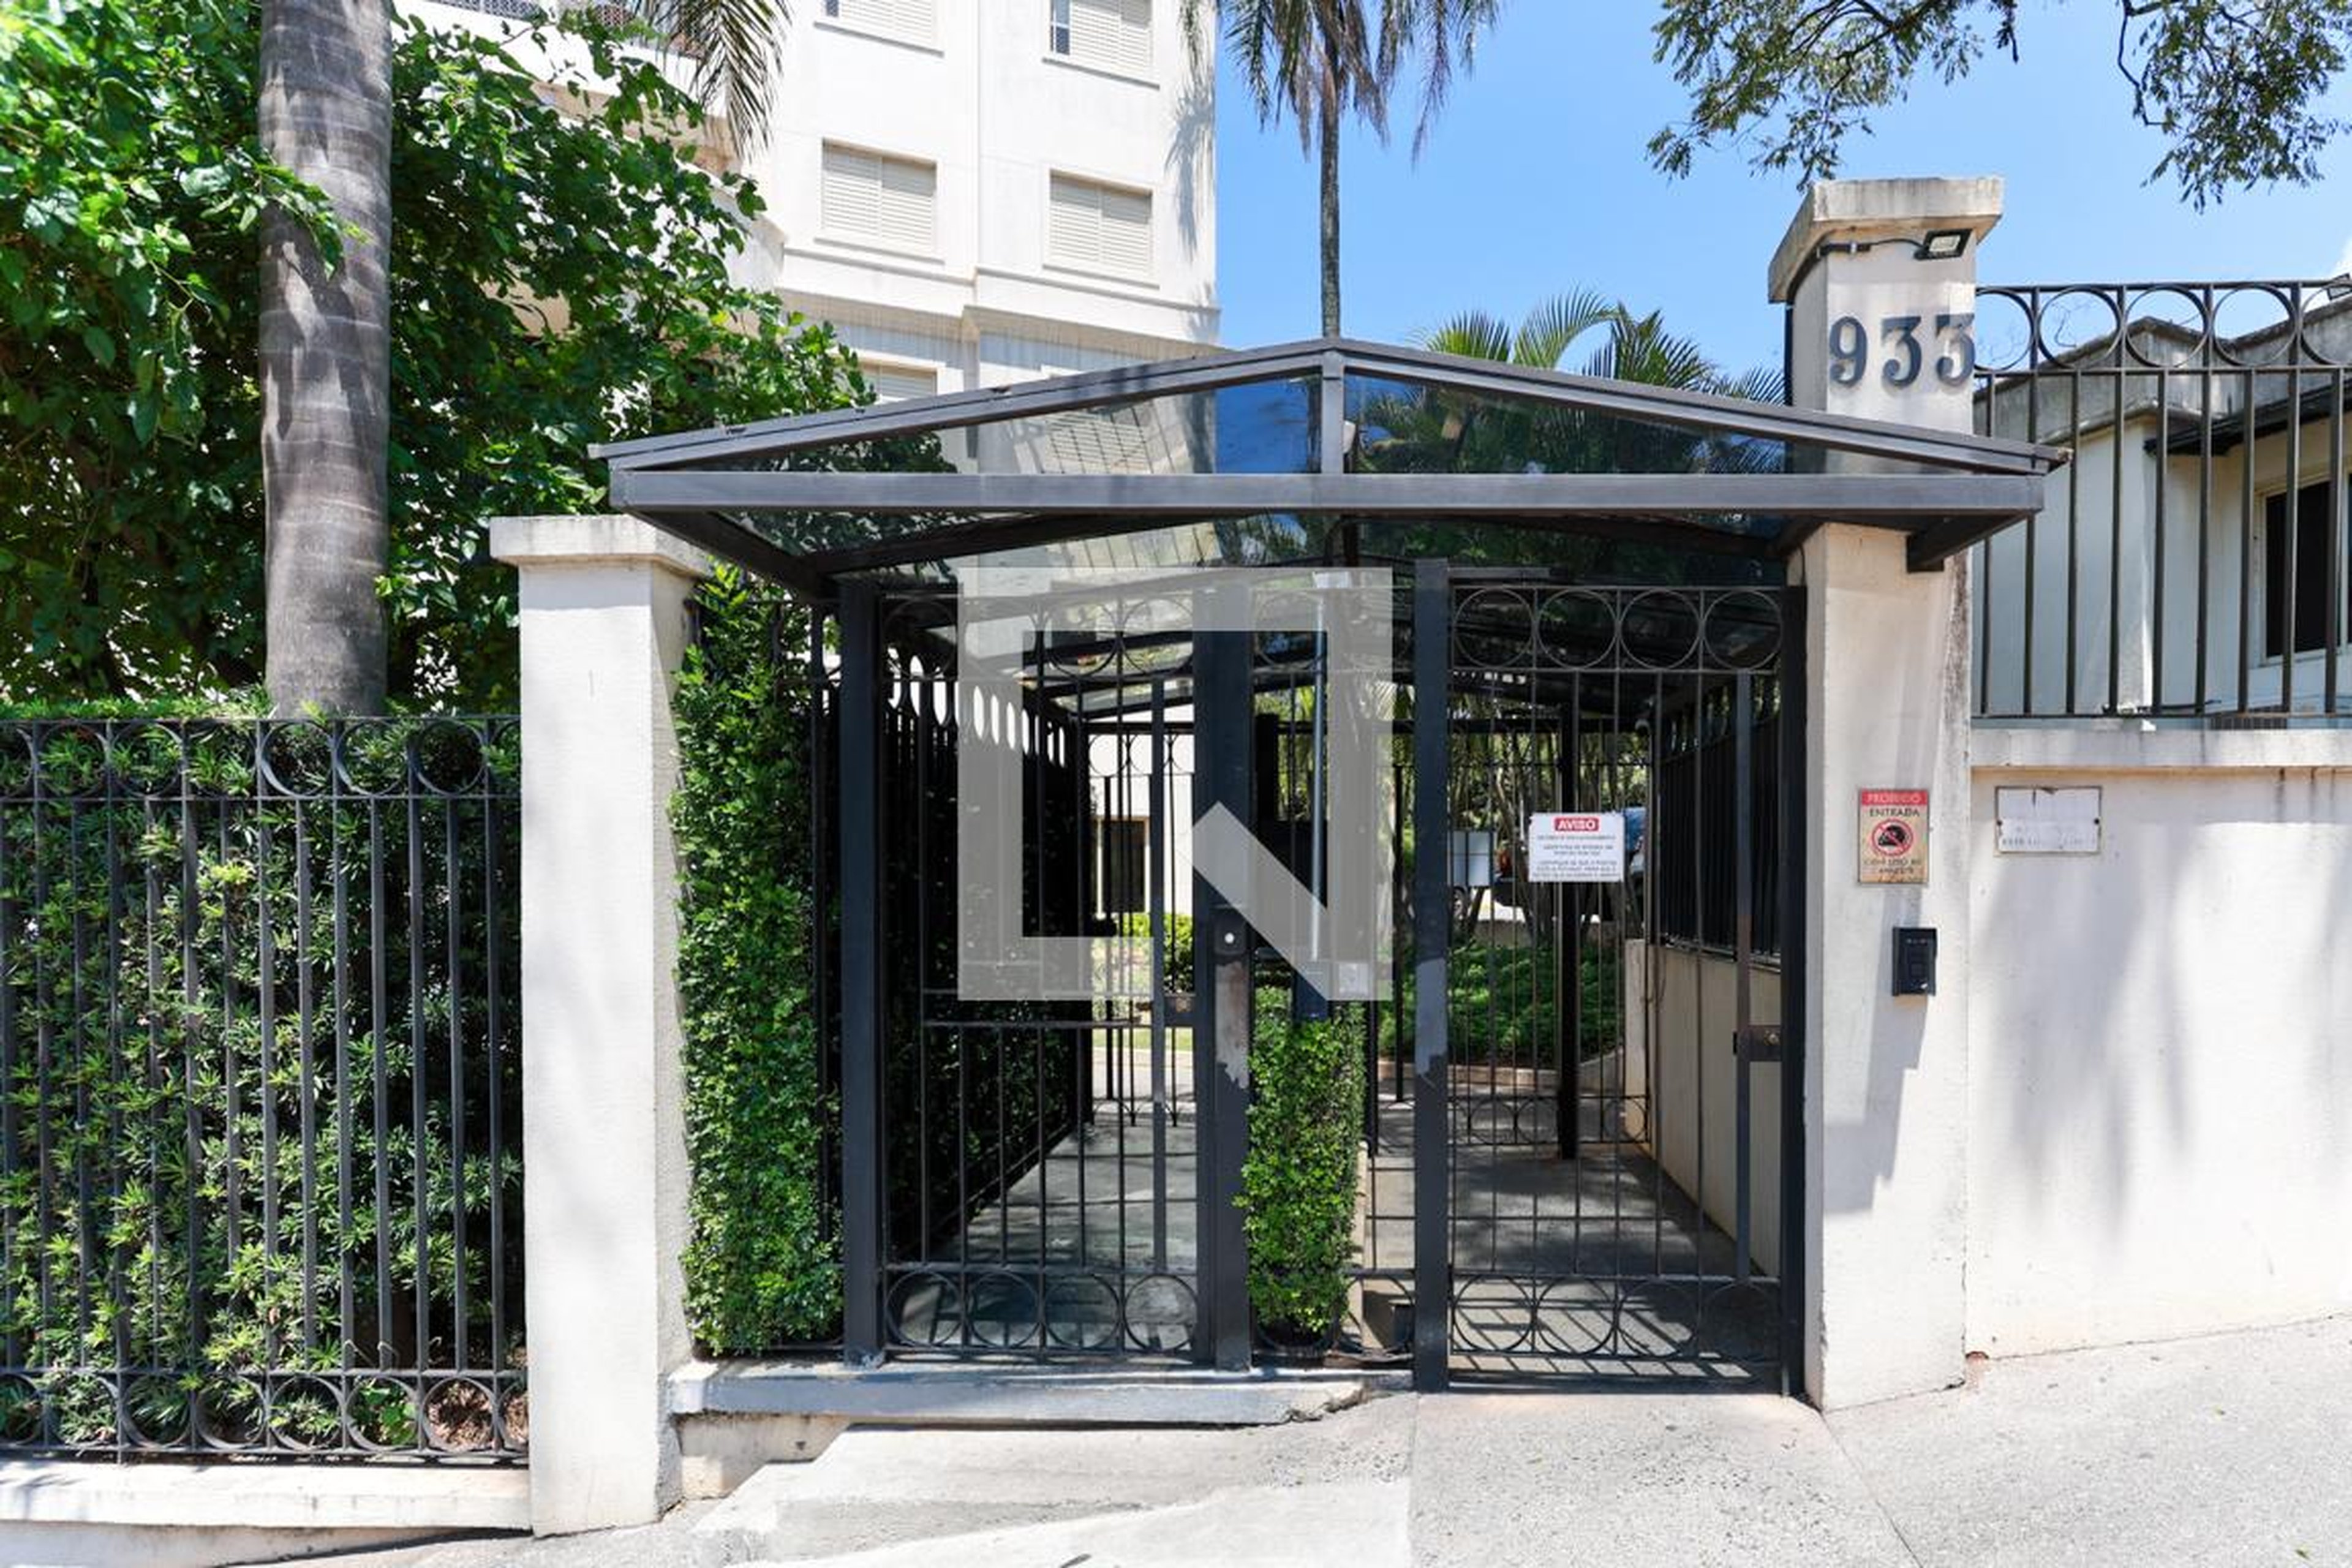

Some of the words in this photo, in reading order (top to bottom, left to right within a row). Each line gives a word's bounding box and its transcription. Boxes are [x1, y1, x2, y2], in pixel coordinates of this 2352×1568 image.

[1828, 314, 1976, 386] 933
[1869, 808, 1921, 817] ENTRADA
[1558, 820, 1596, 830] AVISO
